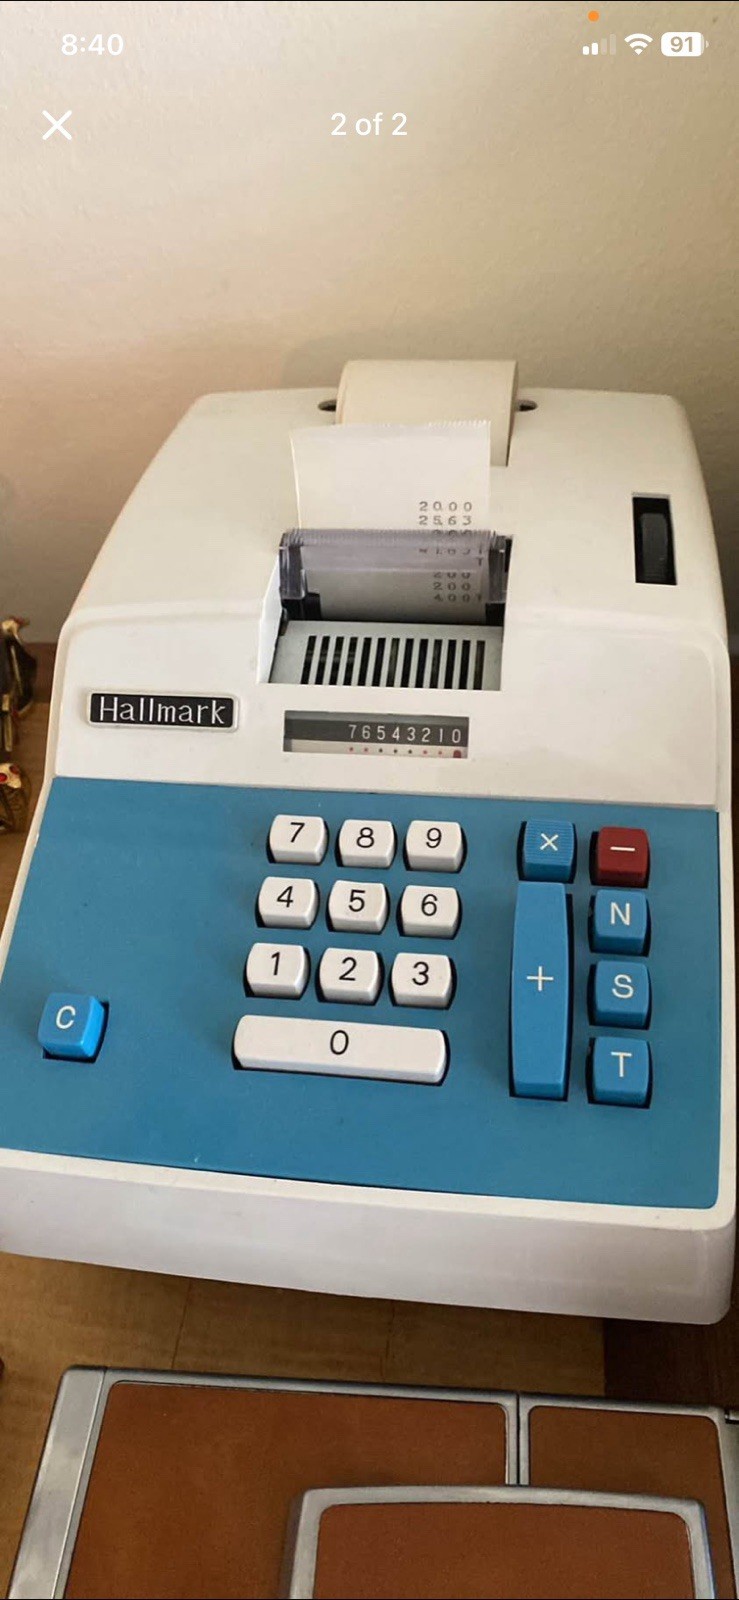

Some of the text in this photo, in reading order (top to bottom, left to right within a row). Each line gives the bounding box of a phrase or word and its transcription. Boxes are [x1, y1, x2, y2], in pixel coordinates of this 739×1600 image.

[99, 696, 226, 725] Hallmark
[289, 821, 442, 849] 7 8 9
[276, 885, 438, 917] 4 5 6
[610, 902, 631, 926] N
[270, 951, 430, 986] 1 2 3
[611, 973, 635, 999] S
[56, 1005, 76, 1030] C
[329, 1029, 350, 1055] 0
[610, 1051, 633, 1078] T
